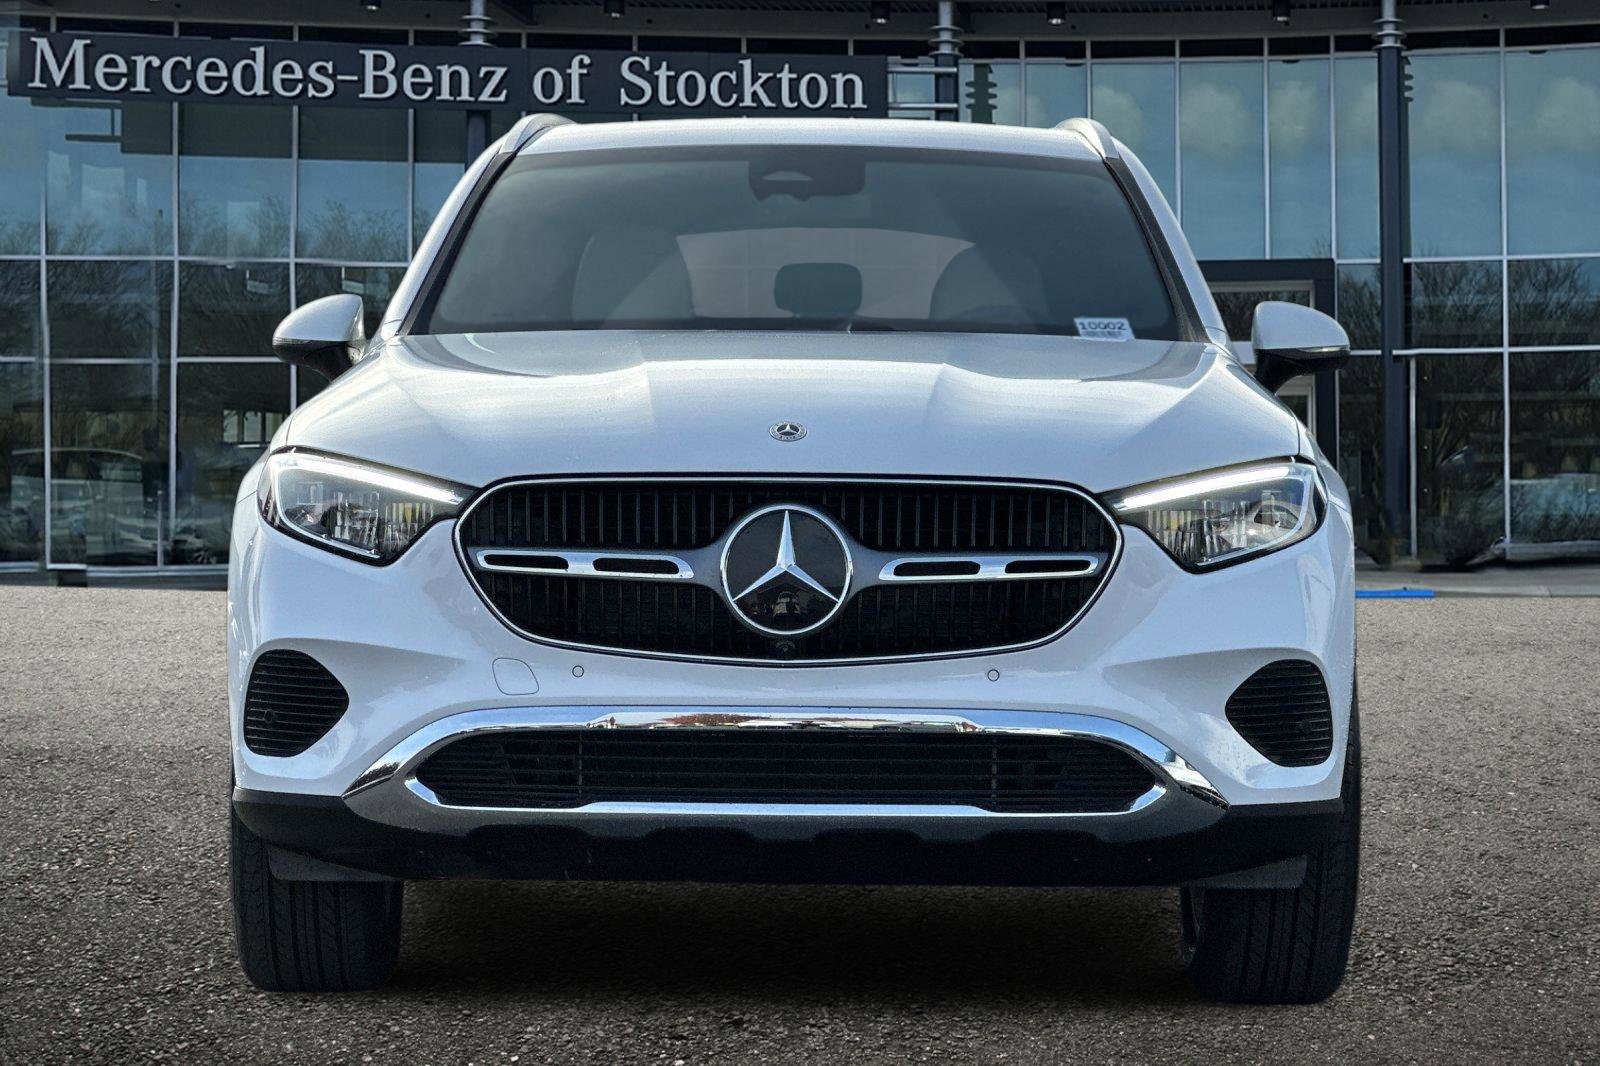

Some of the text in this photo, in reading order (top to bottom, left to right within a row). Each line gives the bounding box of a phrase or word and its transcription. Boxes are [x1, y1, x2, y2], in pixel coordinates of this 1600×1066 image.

[27, 36, 868, 109] Mercedes-Benz of Stockton
